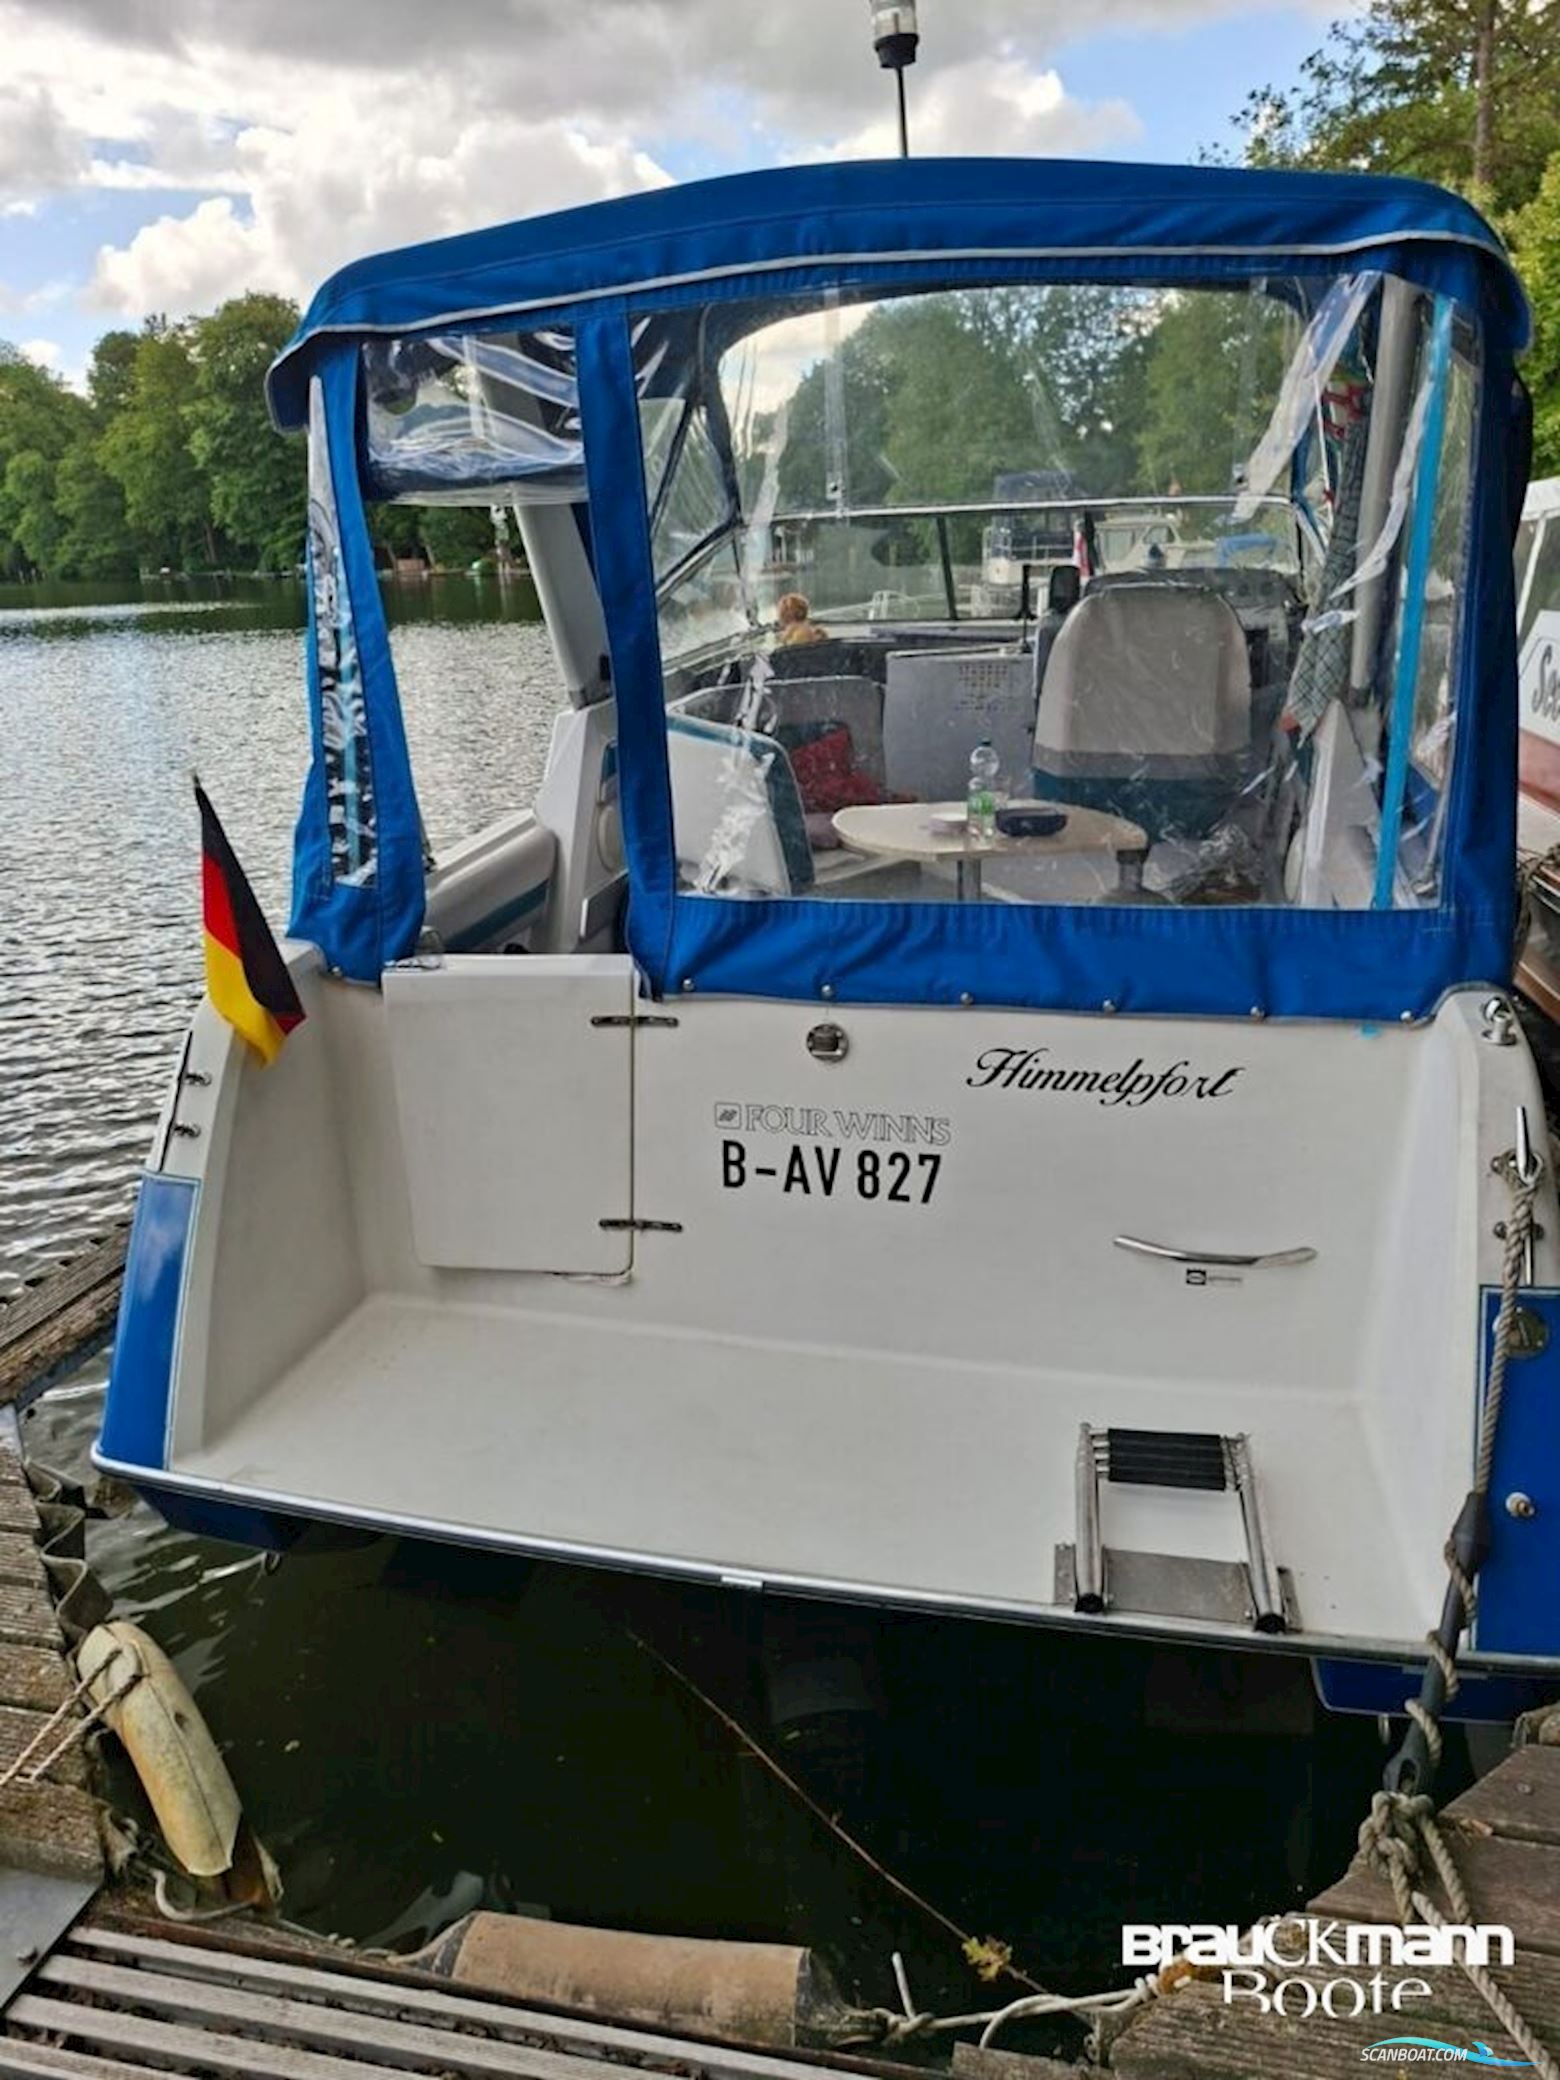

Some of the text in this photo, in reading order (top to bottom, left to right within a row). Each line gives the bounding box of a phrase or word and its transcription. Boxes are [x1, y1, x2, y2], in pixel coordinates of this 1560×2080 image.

[966, 1048, 1246, 1107] Himmelpfort
[745, 1104, 951, 1146] FOUR WINNS
[722, 1139, 942, 1204] B-AV 827
